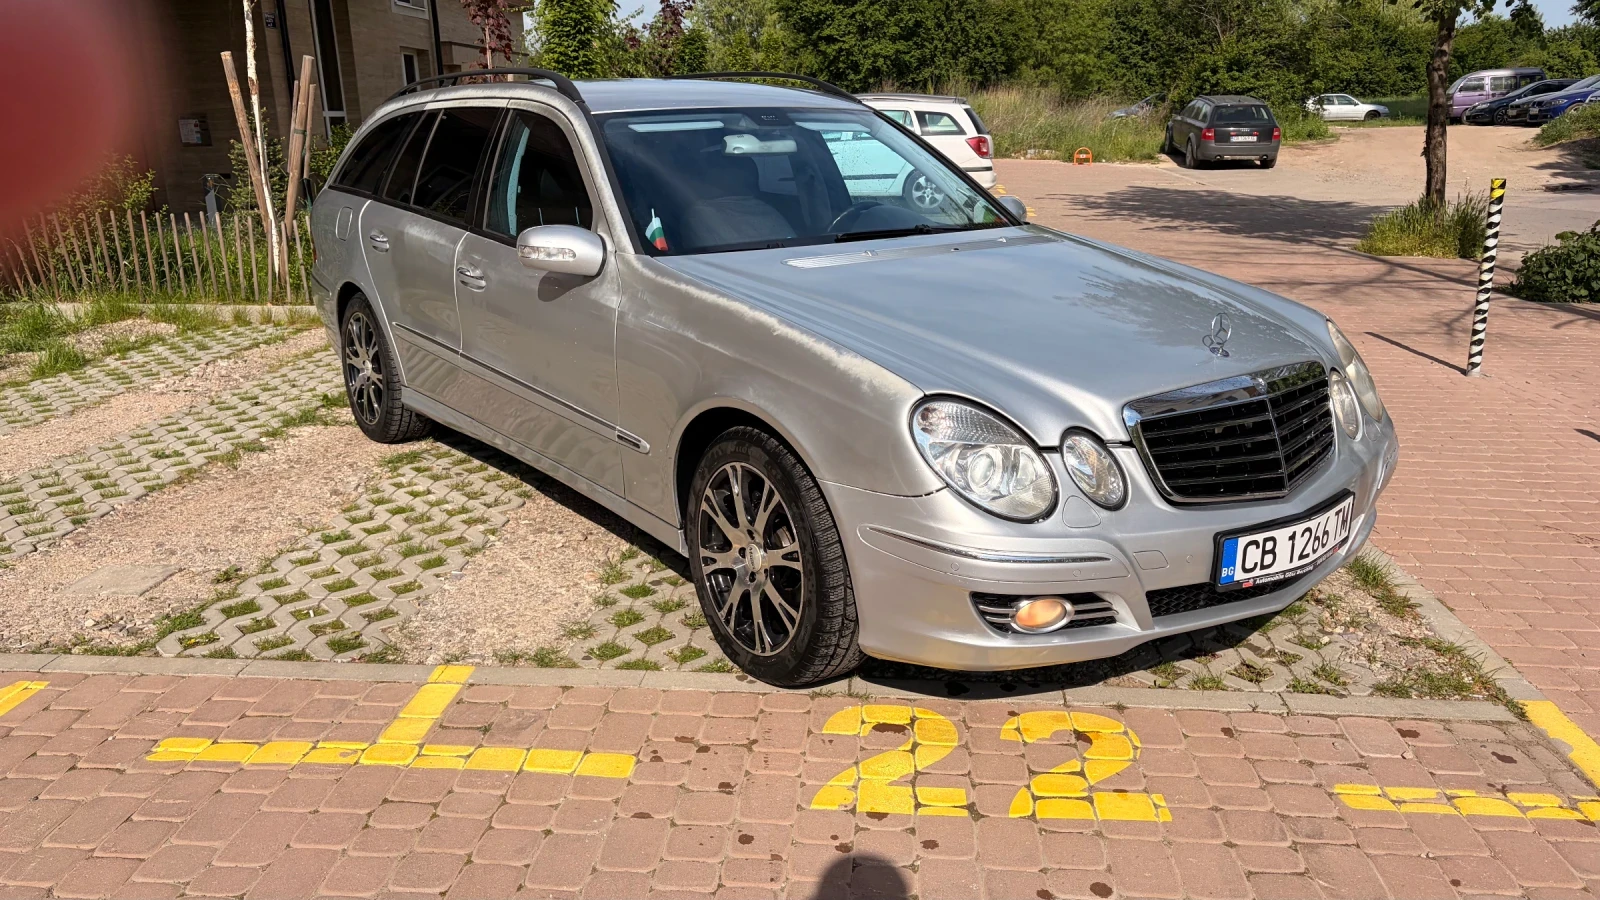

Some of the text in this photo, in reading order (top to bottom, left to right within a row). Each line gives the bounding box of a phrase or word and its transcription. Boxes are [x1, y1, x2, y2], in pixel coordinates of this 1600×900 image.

[1221, 566, 1234, 577] BG
[1241, 502, 1351, 574] CB 1266 TM
[810, 705, 1172, 821] 22
